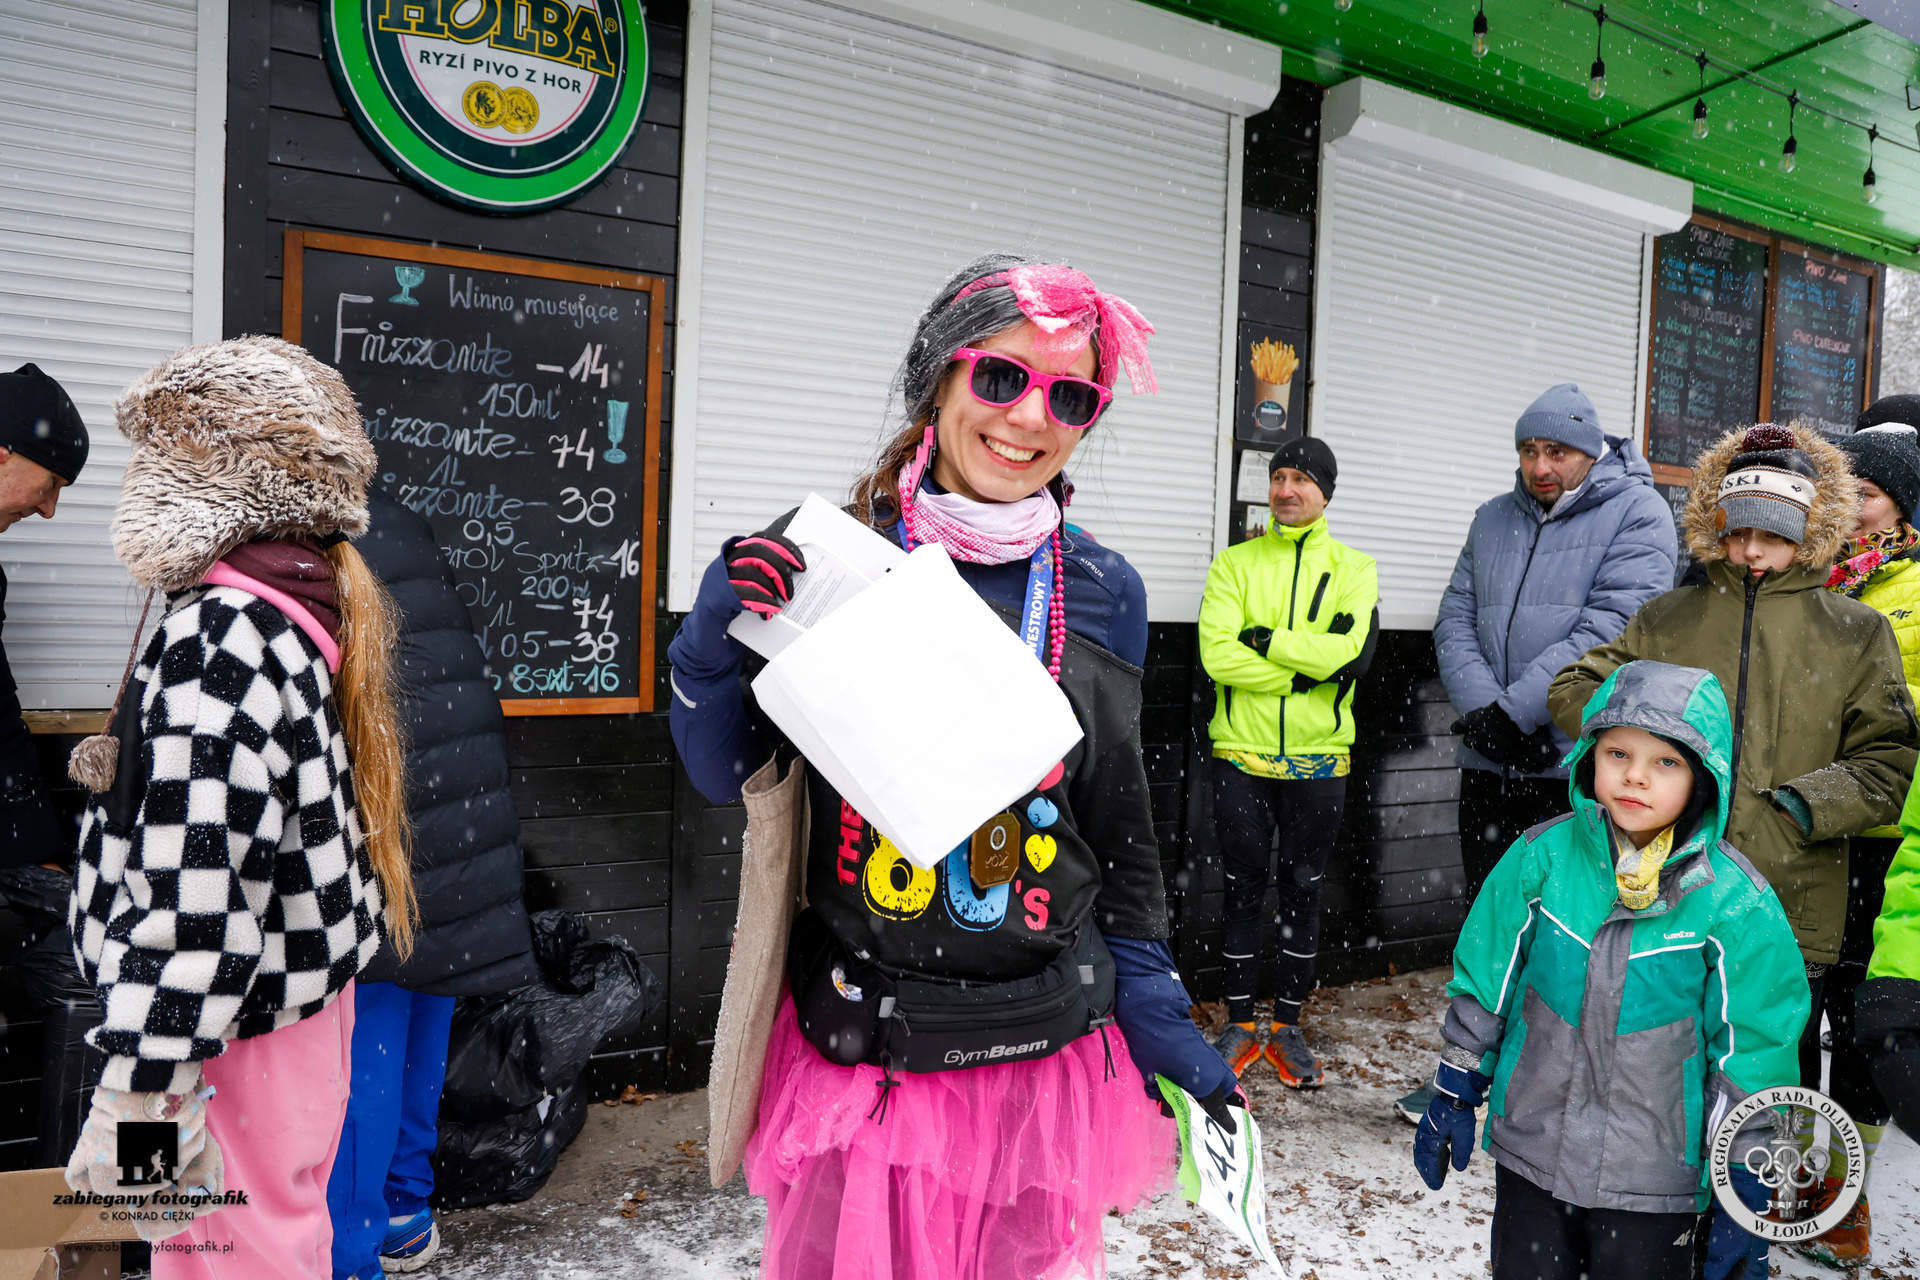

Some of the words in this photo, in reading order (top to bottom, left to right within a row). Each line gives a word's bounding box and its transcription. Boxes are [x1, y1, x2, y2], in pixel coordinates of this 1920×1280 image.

[379, 0, 615, 77] HOLBA
[419, 50, 465, 69] RYZÍ
[473, 58, 519, 80] PIVO
[525, 70, 537, 83] Z
[543, 73, 582, 93] HOR
[449, 273, 515, 311] Winno
[525, 293, 620, 329] musujące
[549, 428, 594, 472] 74
[557, 486, 617, 528] 38
[463, 519, 515, 547] 0,5
[837, 797, 864, 886] THE
[944, 1039, 1049, 1067] GymBeam
